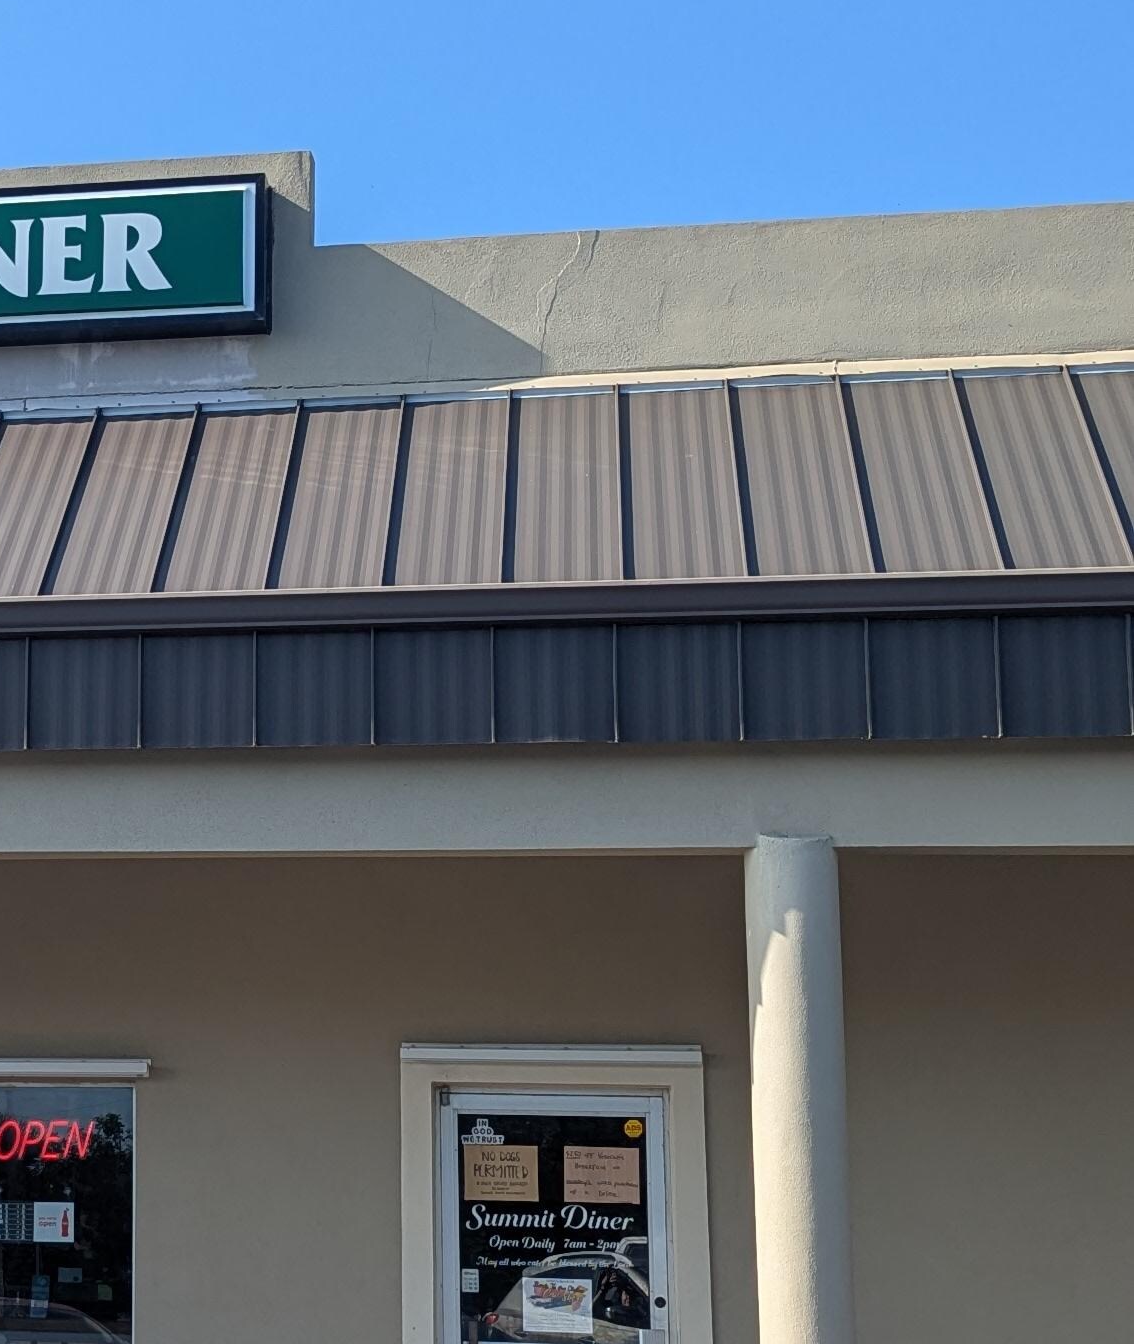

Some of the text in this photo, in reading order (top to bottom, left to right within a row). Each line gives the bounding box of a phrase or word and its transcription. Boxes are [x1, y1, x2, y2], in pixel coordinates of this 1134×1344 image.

[482, 1151, 521, 1162] NO DOGS
[473, 1163, 529, 1179] PERMITTED
[466, 1203, 634, 1231] Summit Diner
[489, 1234, 519, 1251] Open
[521, 1236, 556, 1253] Daily
[563, 1238, 587, 1249] 7am
[596, 1239, 620, 1252] 2pm
